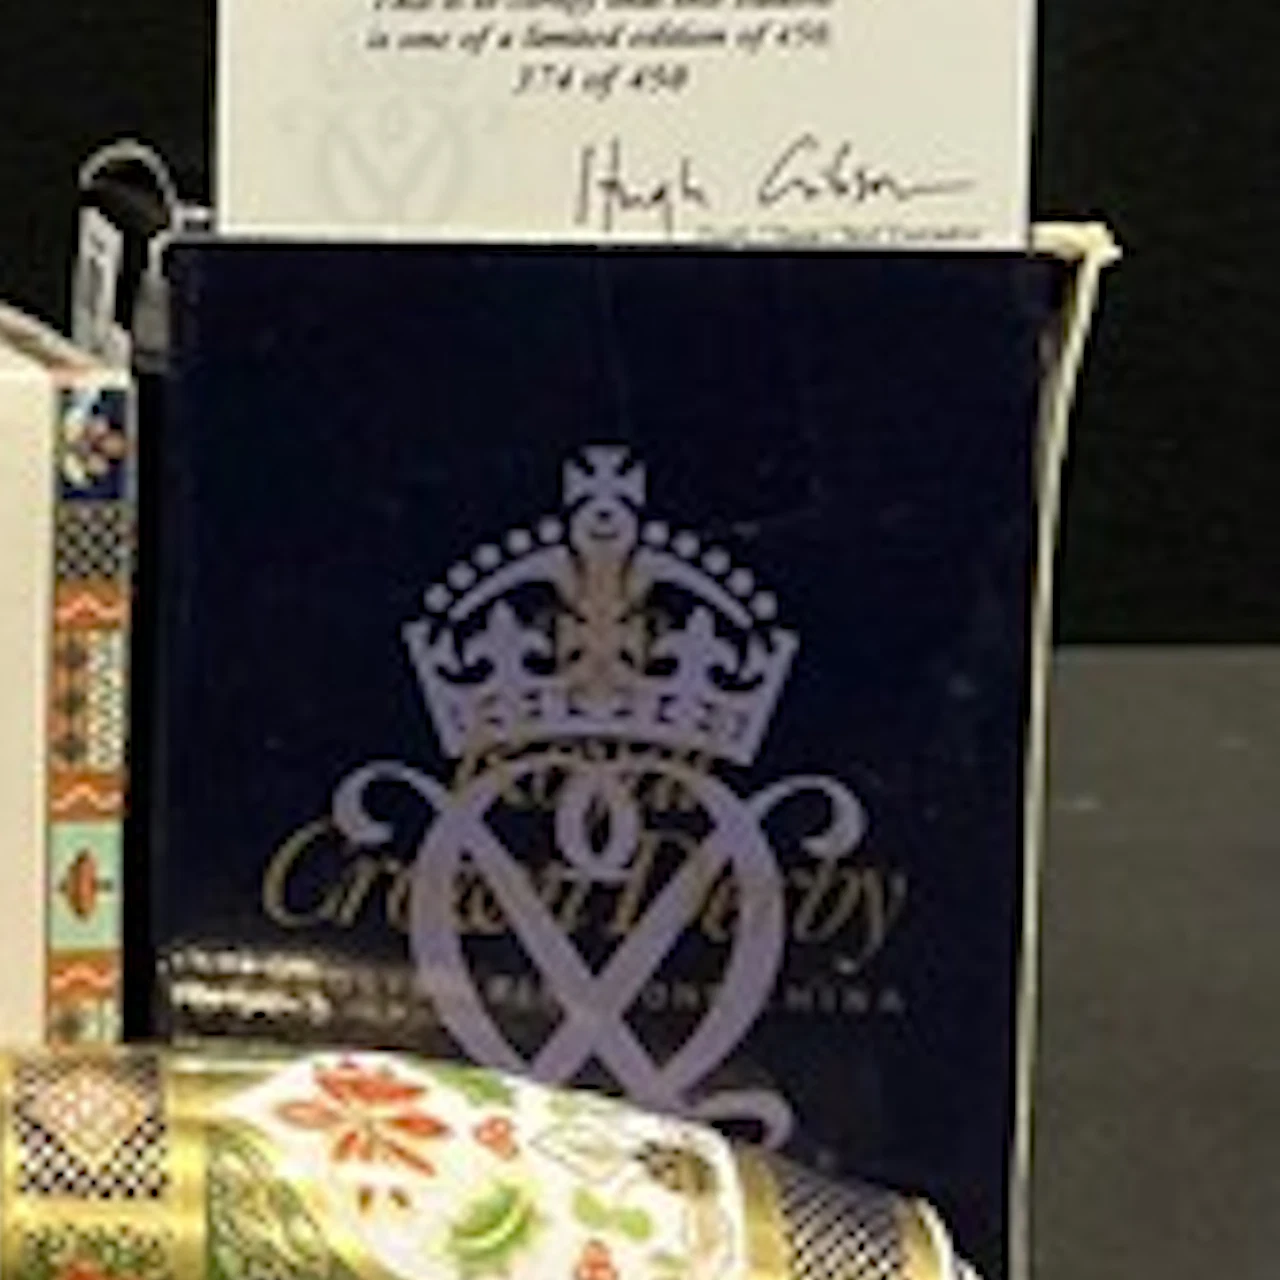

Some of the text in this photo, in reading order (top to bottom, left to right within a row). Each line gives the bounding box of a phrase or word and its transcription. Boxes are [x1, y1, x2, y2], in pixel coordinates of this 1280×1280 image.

[457, 20, 496, 56] of
[734, 19, 773, 56] of
[581, 62, 623, 102] of
[608, 828, 910, 976] Deby
